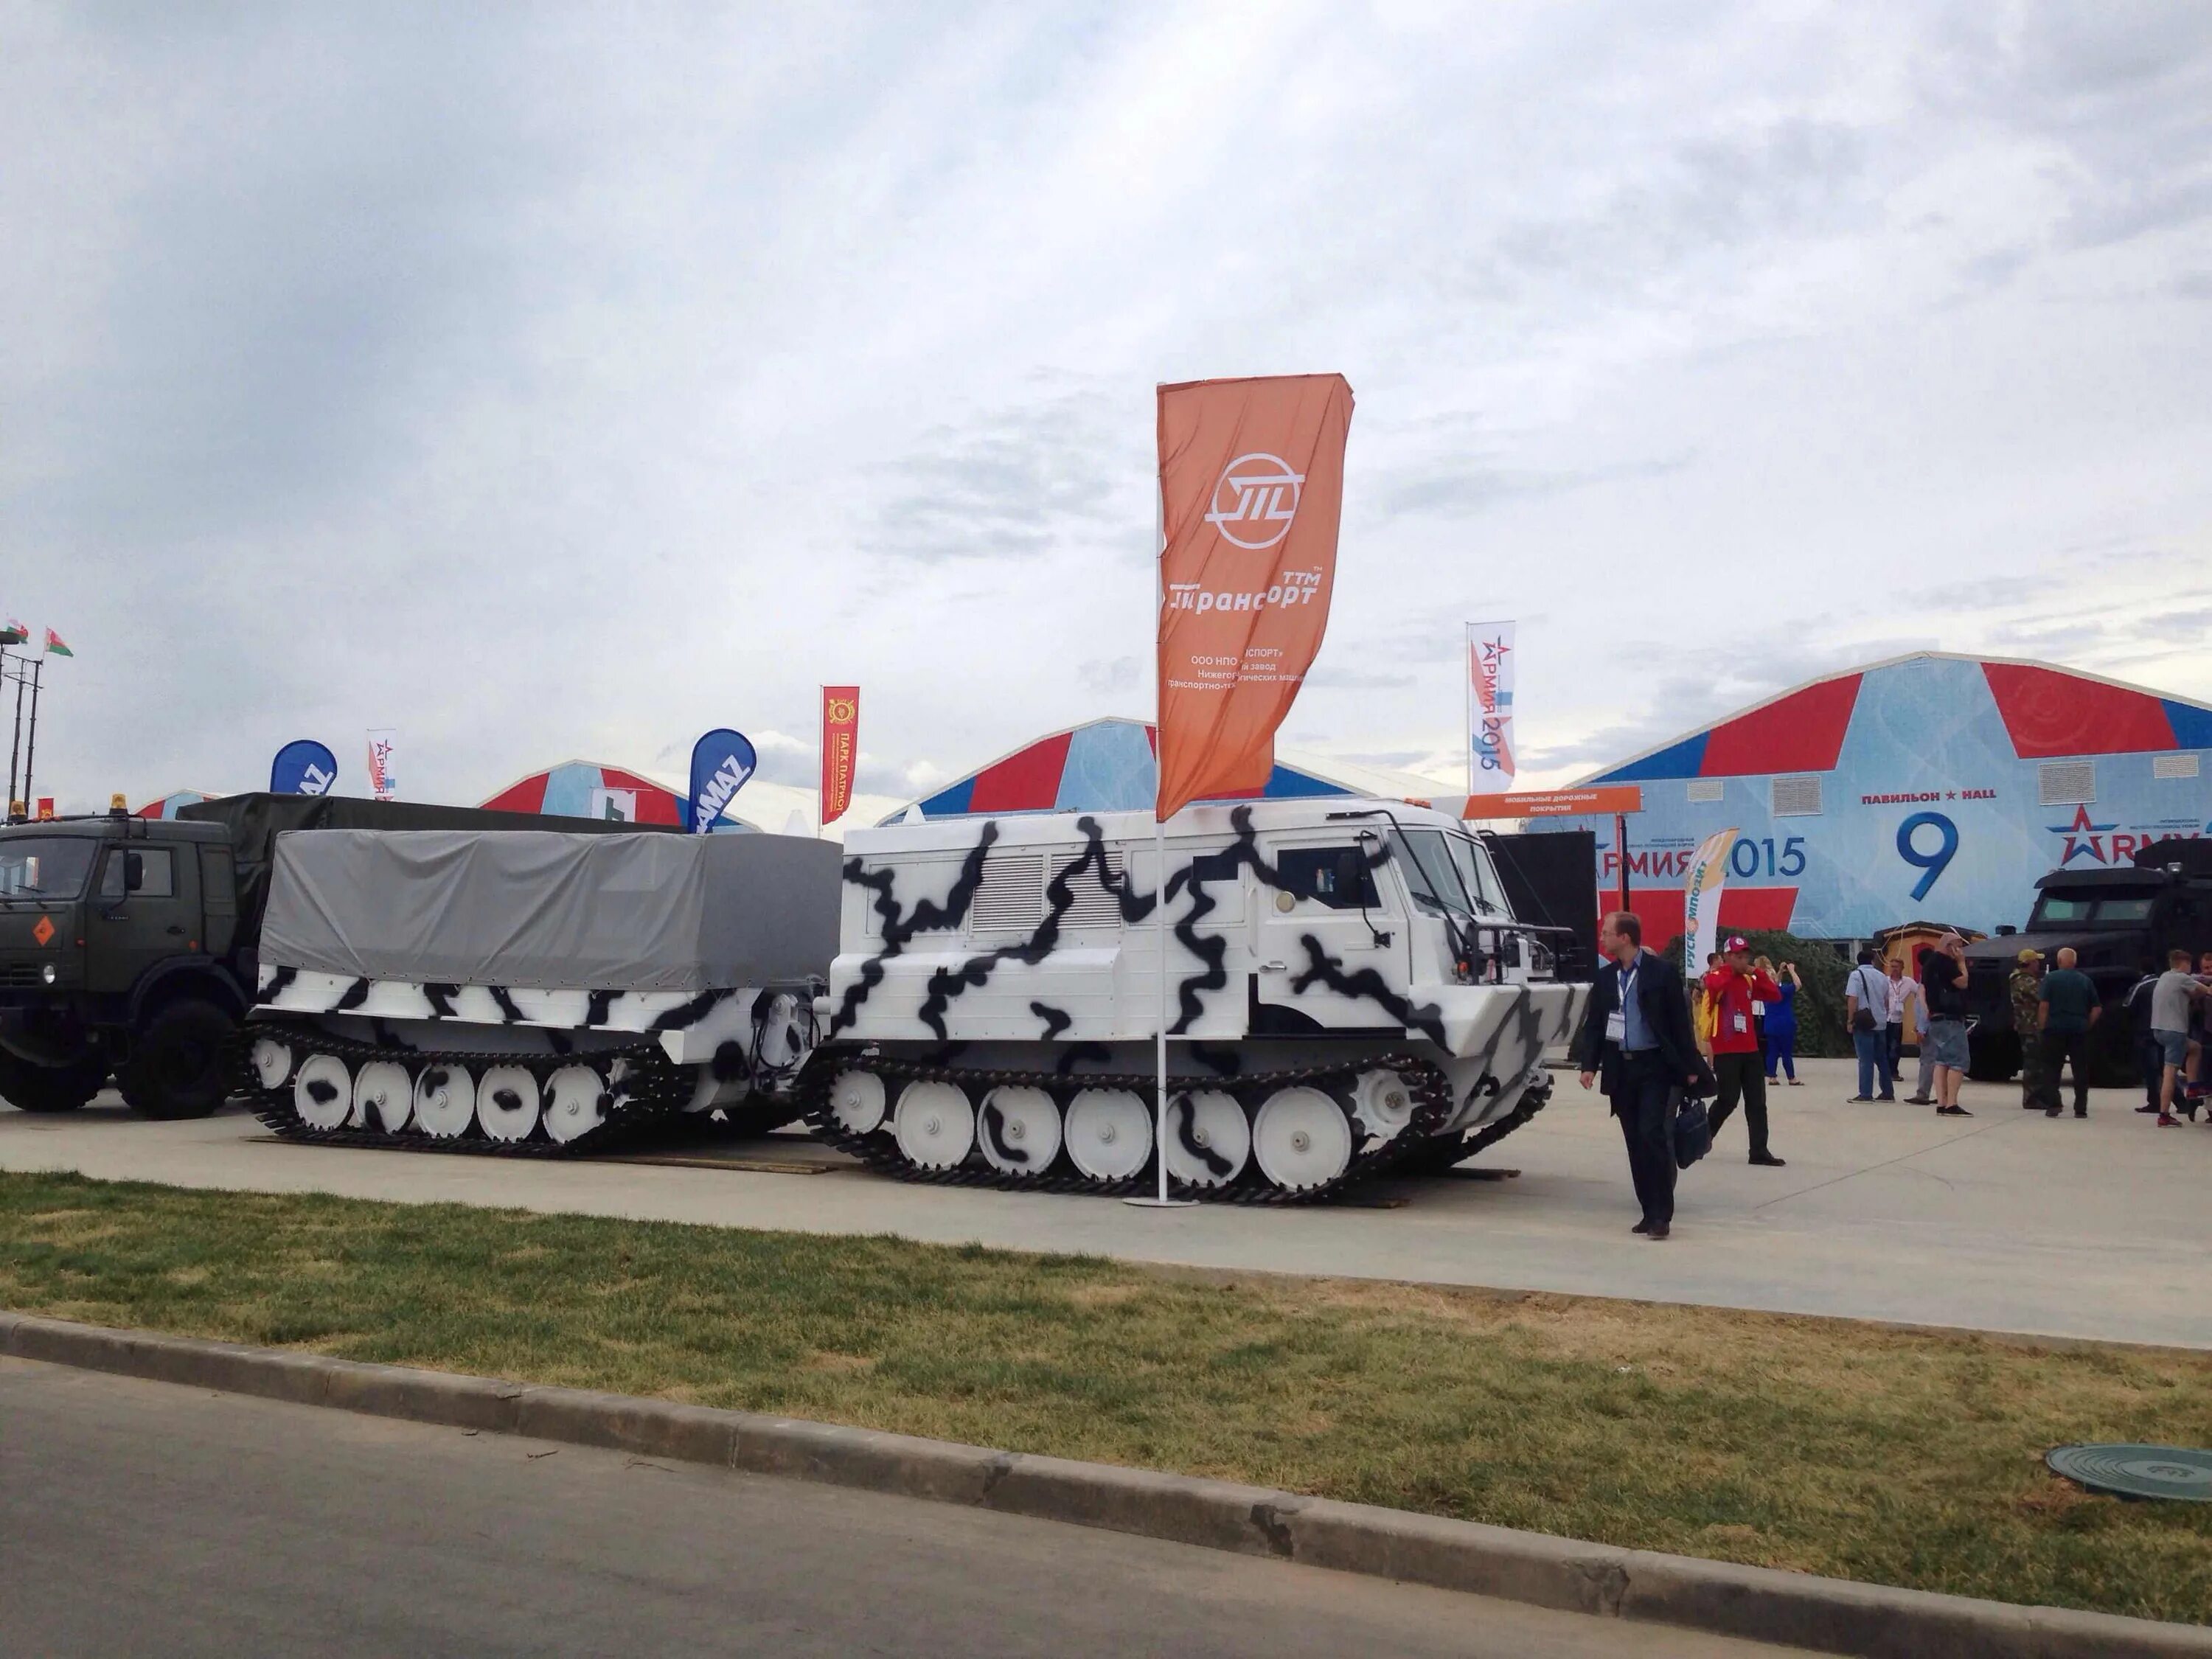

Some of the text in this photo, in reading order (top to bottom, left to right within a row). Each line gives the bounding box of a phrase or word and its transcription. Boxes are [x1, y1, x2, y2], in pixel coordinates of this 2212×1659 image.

[1283, 571, 1321, 586] ТТМ
[1169, 583, 1318, 615] Трансорт
[1191, 655, 1213, 665] ООО
[1216, 657, 1238, 666] НПО
[1481, 636, 1509, 771] АРМИЯ 2015
[839, 733, 849, 762] ПАРК
[1505, 793, 1598, 804] МОБИЛЬНЫЕ ДОРОЖНЫЕ
[1862, 789, 1997, 805] ПАВИЛЬОН HALL
[1530, 804, 1571, 813] ПОКРЫТИЯ
[1596, 836, 1806, 879] РМИЯ 015
[1896, 811, 1959, 902] 9
